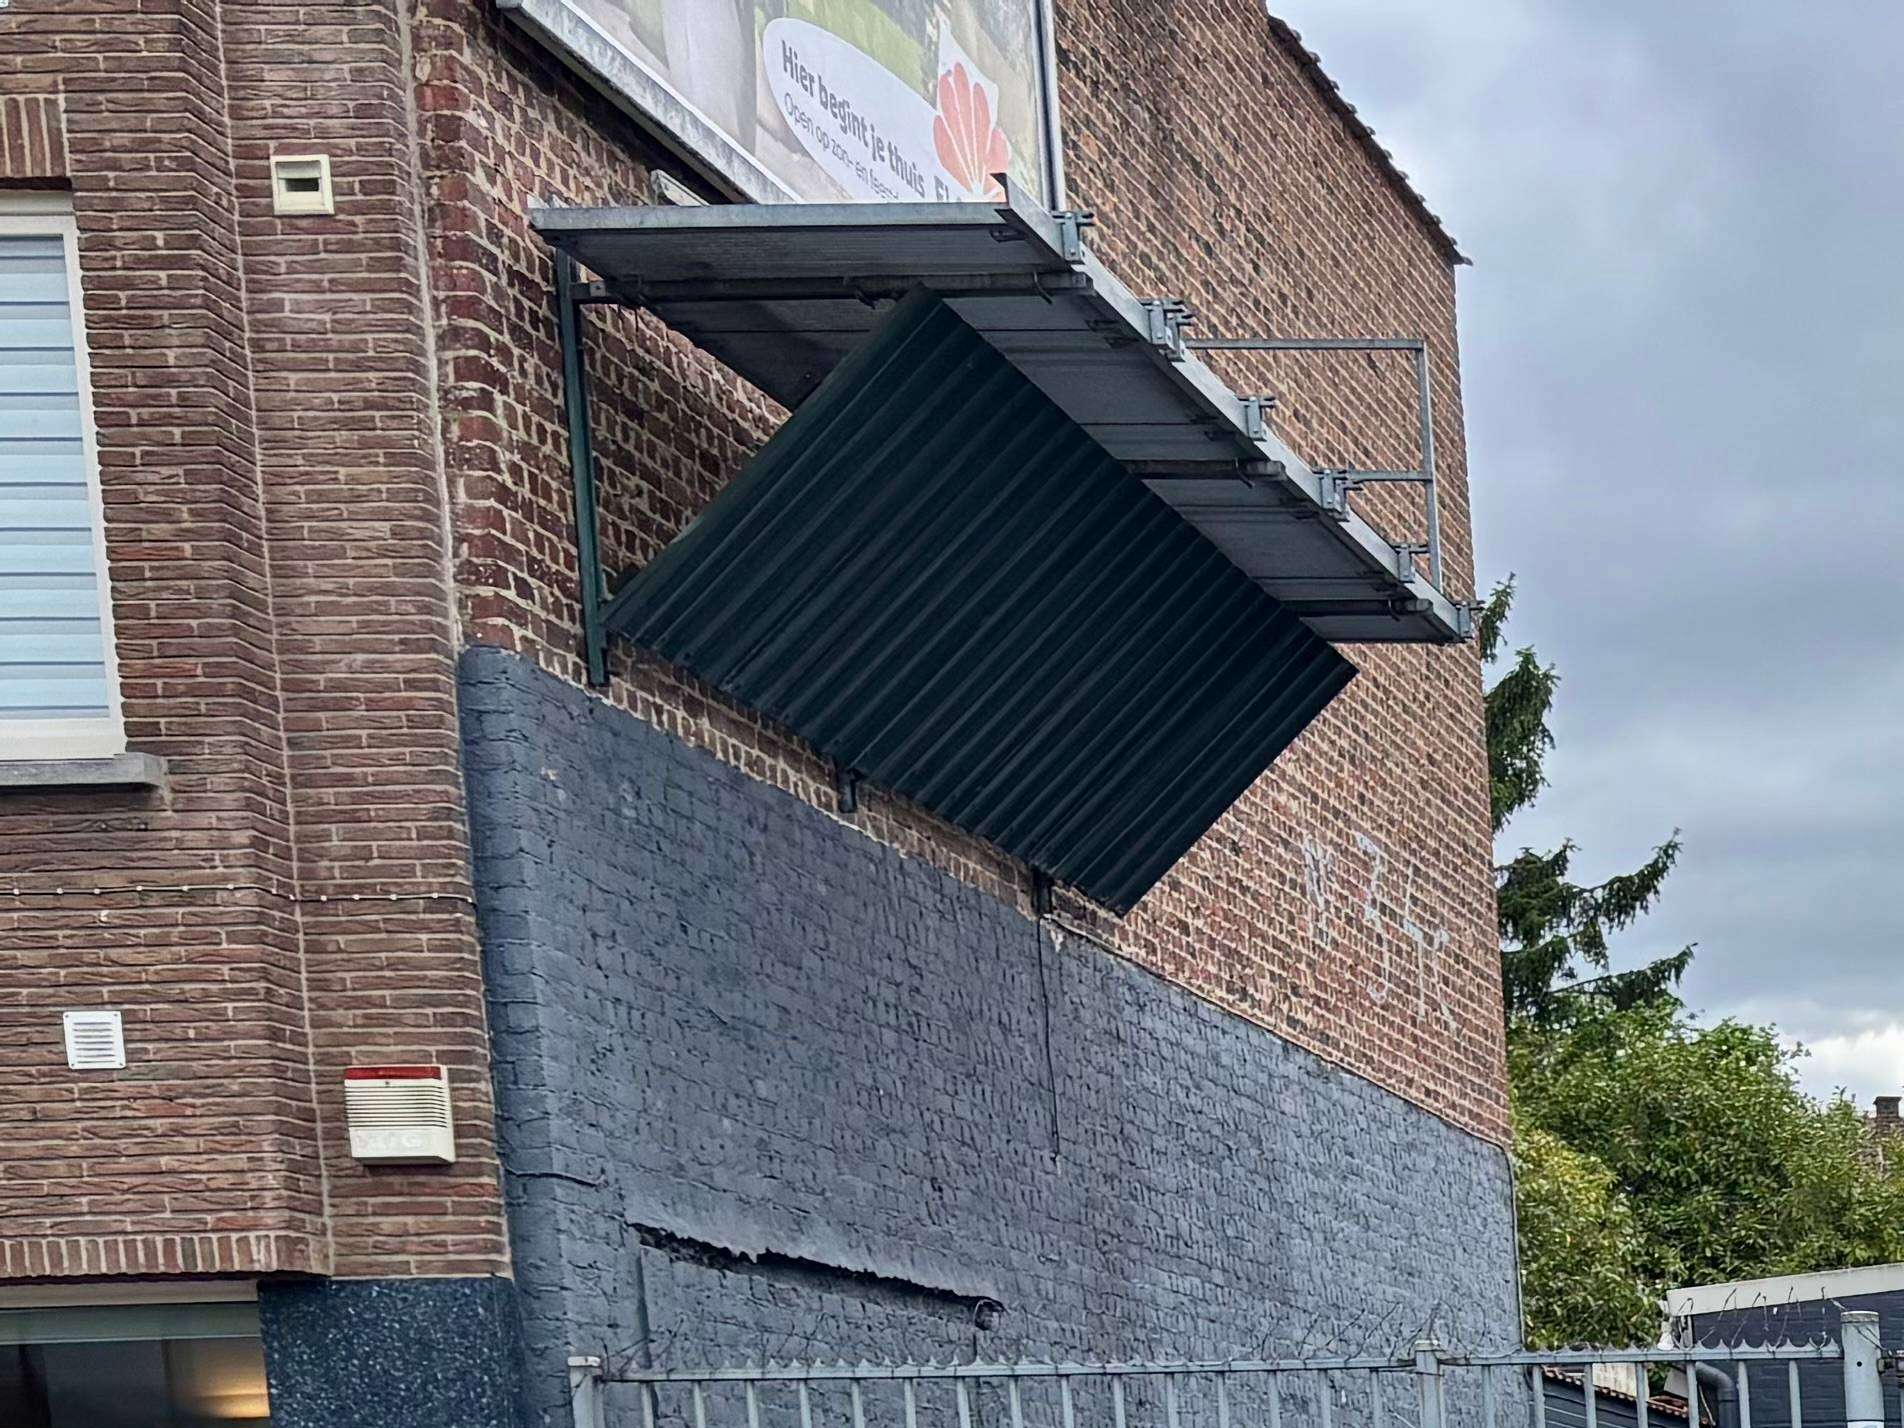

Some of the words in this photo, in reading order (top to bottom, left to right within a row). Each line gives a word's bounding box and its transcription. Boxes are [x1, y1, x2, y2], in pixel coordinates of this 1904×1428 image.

[781, 39, 816, 98] Hier
[818, 74, 870, 149] begint
[871, 125, 886, 164] je
[889, 141, 926, 198] thuis
[784, 92, 814, 134] Open
[815, 126, 830, 153] op
